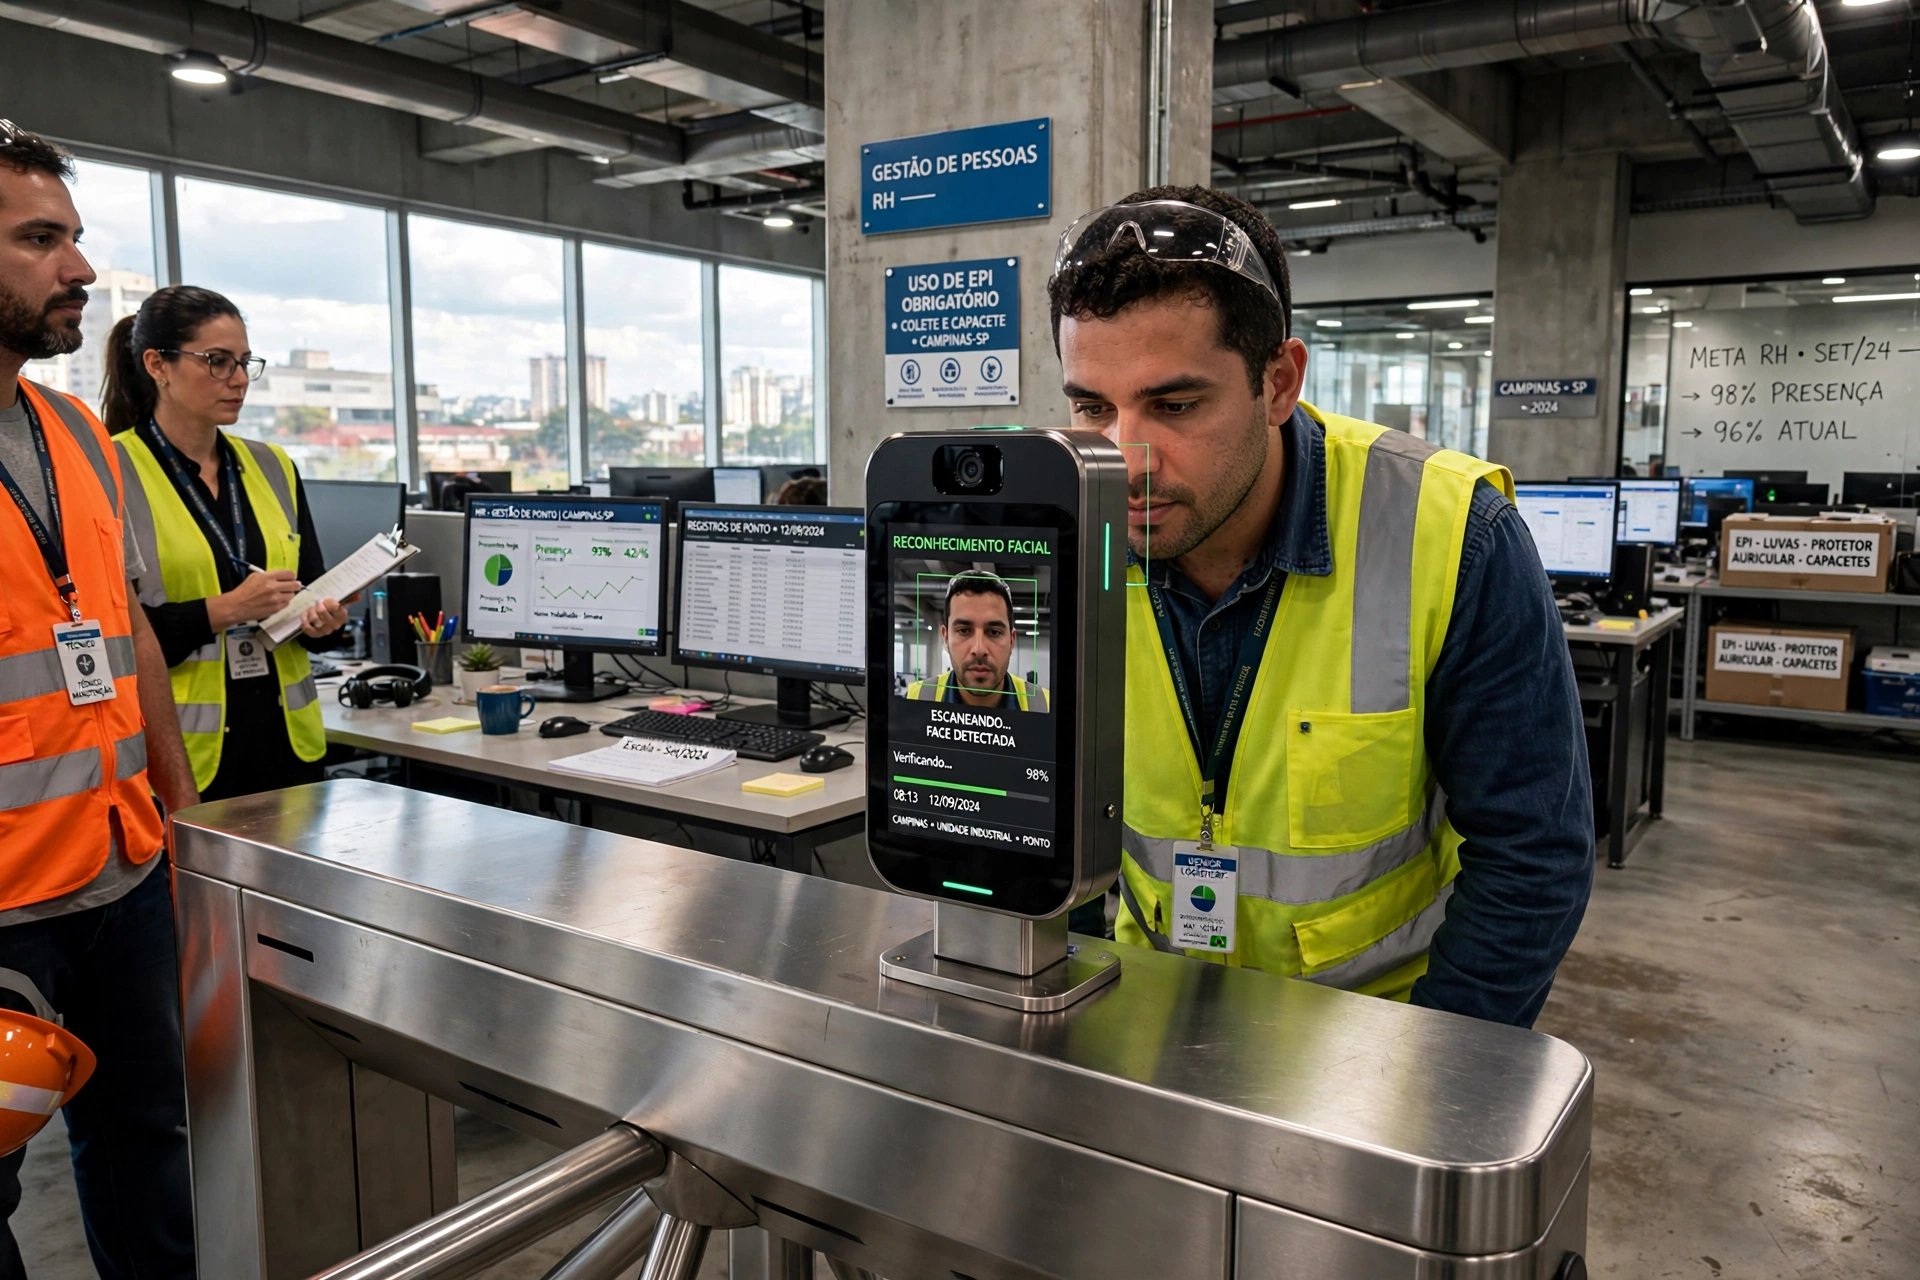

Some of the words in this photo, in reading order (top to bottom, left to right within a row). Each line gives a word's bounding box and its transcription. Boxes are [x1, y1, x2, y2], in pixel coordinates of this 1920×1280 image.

[872, 155, 932, 182] GESTÃO
[936, 155, 958, 175] DE
[961, 144, 1038, 171] PESSOAS
[873, 191, 895, 210] RH
[908, 274, 939, 292] USO
[943, 272, 965, 290] DE
[968, 269, 993, 288] EPI
[901, 289, 1000, 313] OBRIGATÓRIO
[900, 317, 940, 333] COLETE
[942, 317, 949, 330] E
[951, 314, 1006, 330] CAPACETE
[919, 332, 990, 348] CAMPINAS-SP
[1690, 346, 1746, 369] META
[1760, 343, 1788, 365] RH
[1814, 336, 1891, 366] SET/24
[1500, 381, 1562, 395] CAMPINAS
[1571, 381, 1588, 394] SP
[1711, 382, 1756, 406] 98%
[1771, 380, 1884, 406] PRESENÇA
[1530, 401, 1559, 414] 2024
[1714, 420, 1762, 443] 96%
[1778, 420, 1858, 441] ATUAL
[521, 509, 531, 519] DE
[532, 509, 558, 520] PONTO
[687, 520, 729, 533] REGISTROS
[730, 522, 742, 533] DE
[743, 522, 771, 534] PONTO
[893, 535, 1004, 553] RECONHECIMENTO
[1008, 539, 1051, 555] FACIAL
[1735, 536, 1753, 548] EPI
[1763, 537, 1800, 549] LUVAS
[1811, 539, 1873, 552] PROTETOR
[1732, 552, 1795, 566] AURICULAR
[1805, 554, 1871, 568] CAPACETES
[1722, 639, 1737, 650] EPI
[1745, 640, 1776, 652] LUVAS
[1785, 643, 1838, 657] PROTETOR
[1719, 654, 1773, 666] AURICULAR
[1782, 657, 1838, 671] CAPACETES
[931, 709, 1012, 730] ESCANEANDO...
[926, 725, 951, 740] FACE
[954, 729, 1016, 748] DETECTADA
[893, 750, 953, 769] Verificando...
[1026, 767, 1049, 782] 98%
[929, 794, 981, 812] 12/09/2024
[892, 814, 929, 829] CAMPINAS
[936, 821, 969, 836] UNIDADE
[970, 828, 1013, 843] INDUSTRIAL
[1022, 835, 1051, 849] PONTO
